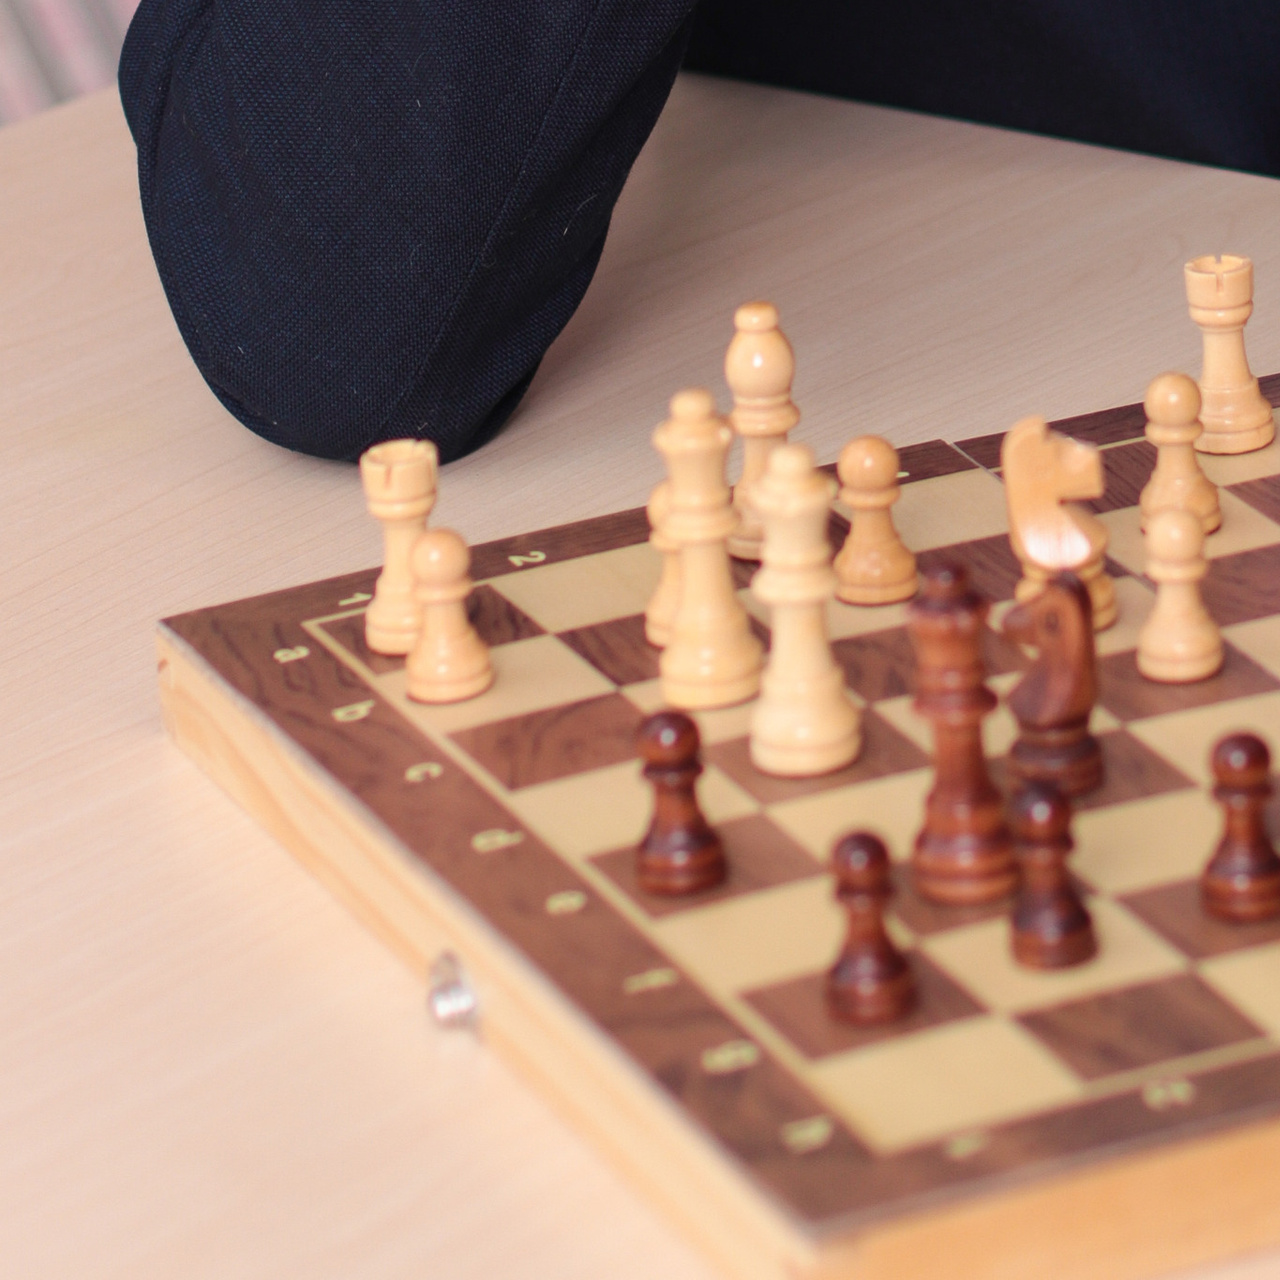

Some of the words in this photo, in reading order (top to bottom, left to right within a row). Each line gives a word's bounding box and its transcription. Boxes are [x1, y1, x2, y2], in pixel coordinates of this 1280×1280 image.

[508, 550, 547, 567] 2
[272, 645, 309, 664] a
[331, 698, 376, 724] b
[405, 761, 444, 783] c
[471, 827, 526, 853] d
